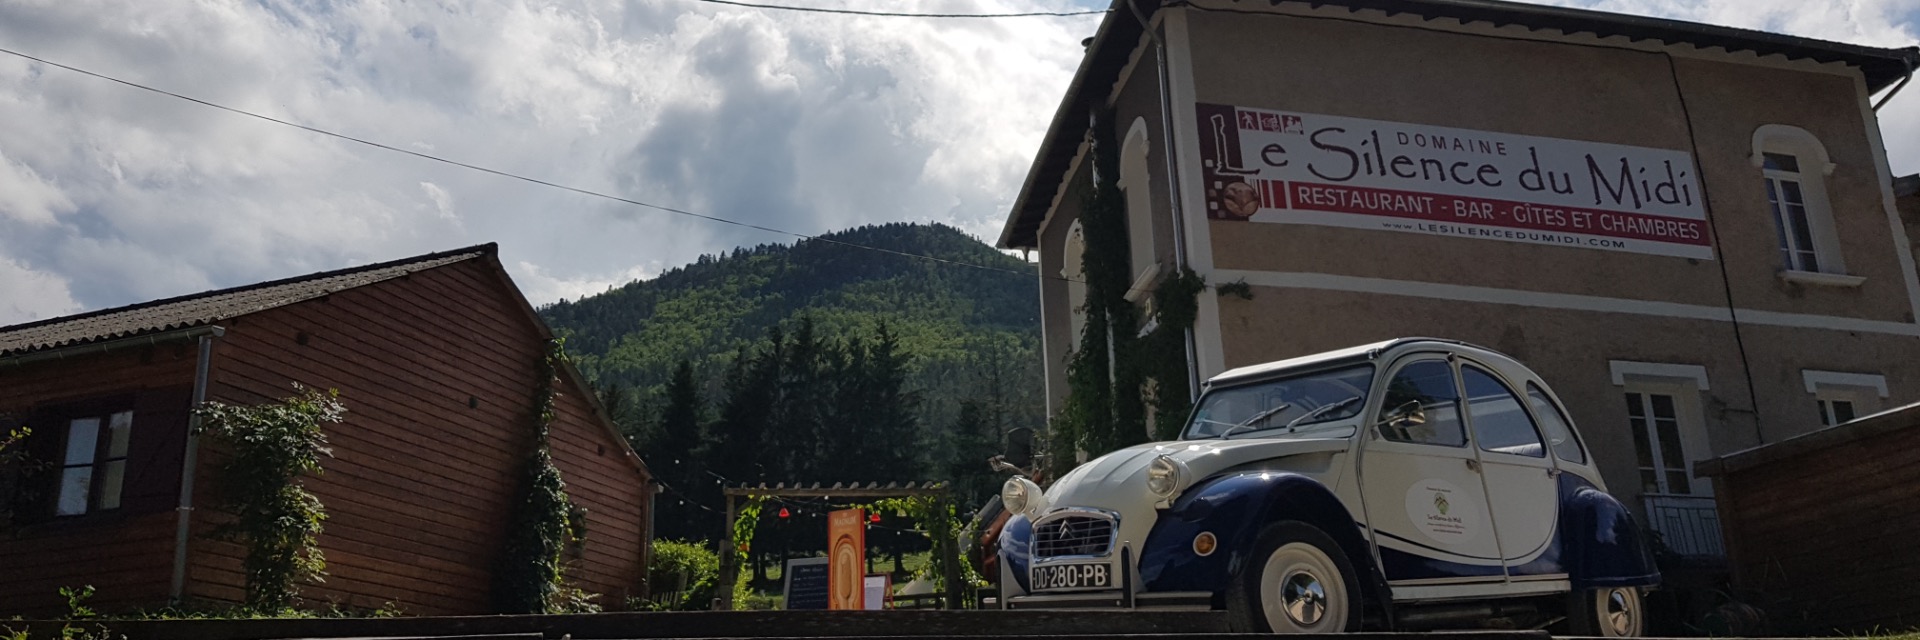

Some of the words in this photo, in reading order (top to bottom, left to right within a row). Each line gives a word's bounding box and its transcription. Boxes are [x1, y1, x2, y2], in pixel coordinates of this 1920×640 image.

[1210, 114, 1288, 176] Le
[1307, 127, 1502, 187] Silence
[1519, 146, 1574, 195] du
[1585, 153, 1692, 209] Midi
[1396, 131, 1507, 155] DOMAINE
[1298, 186, 1434, 214] RESTAURANT
[1454, 200, 1495, 220] BAR
[1512, 203, 1566, 228] GÎTES
[1571, 211, 1593, 229] ET
[1600, 214, 1700, 240] CHAMBRES
